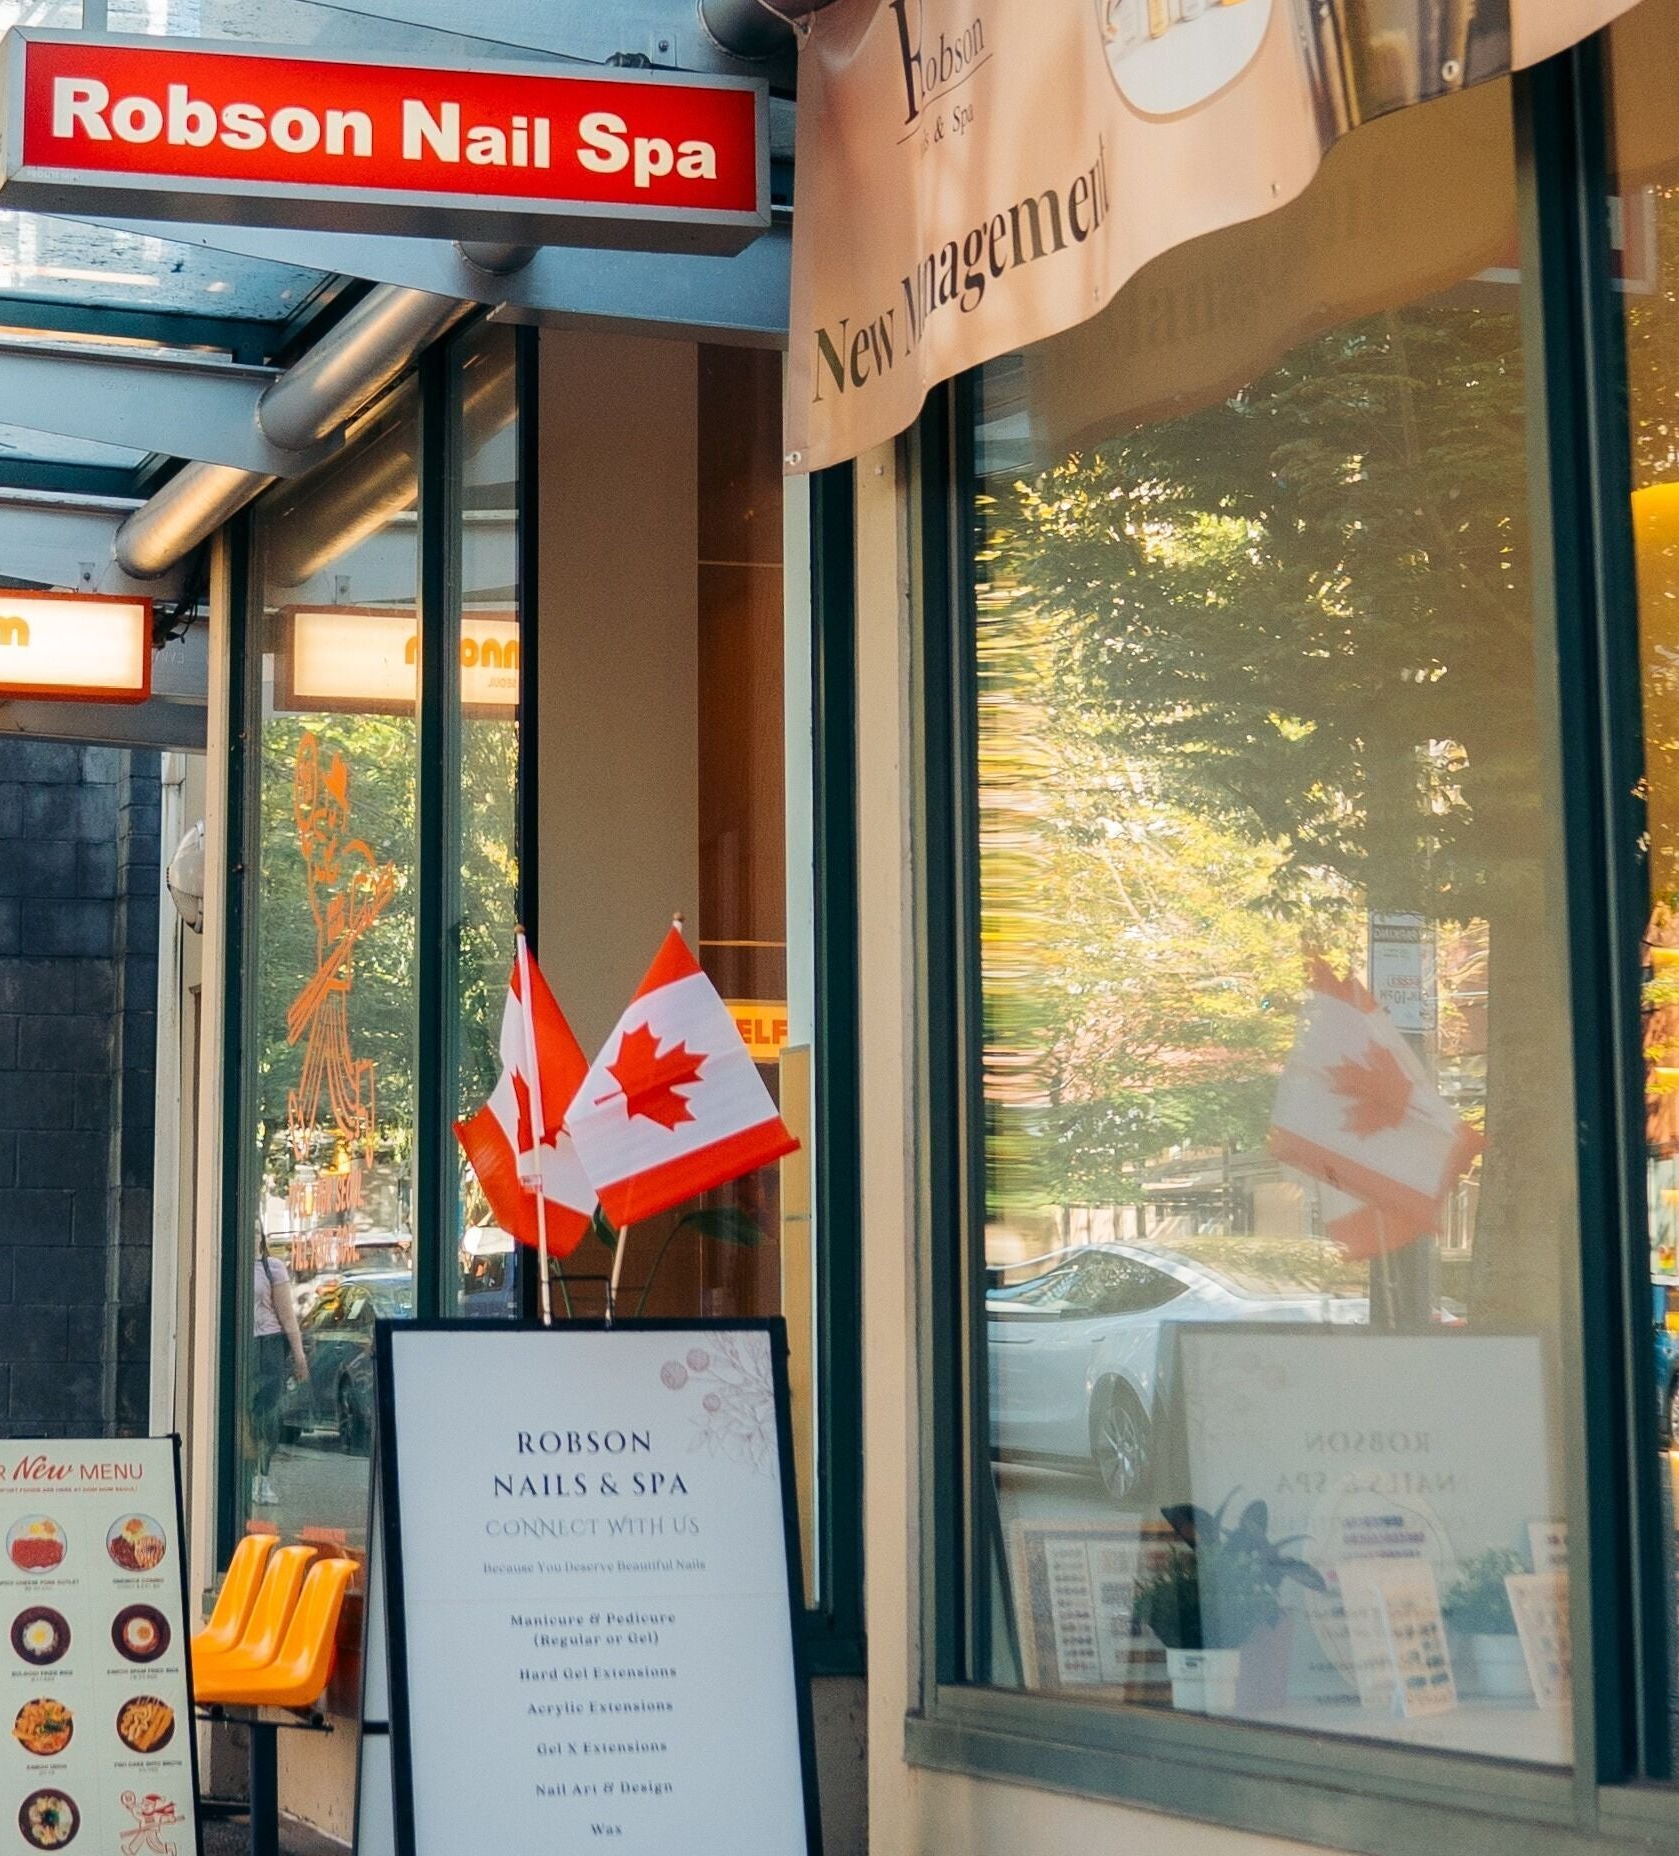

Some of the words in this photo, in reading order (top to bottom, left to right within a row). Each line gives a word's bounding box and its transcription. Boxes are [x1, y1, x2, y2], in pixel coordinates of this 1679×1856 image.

[52, 76, 373, 156] Robson
[402, 99, 550, 169] Nail
[576, 110, 718, 188] Spa
[812, 308, 895, 404] New
[902, 132, 1110, 358] Mnagement
[517, 1430, 652, 1454] ROBSON
[12, 1455, 74, 1481] New
[80, 1463, 143, 1481] MENU
[494, 1472, 588, 1497] NAILS
[600, 1472, 619, 1496] &
[633, 1471, 689, 1495] SPA
[485, 1517, 600, 1538] CONNECT
[606, 1514, 664, 1536] WITH
[673, 1513, 700, 1535] US
[483, 1562, 534, 1574] Because
[537, 1562, 562, 1573] You
[564, 1561, 614, 1573] Deserve
[617, 1559, 673, 1571] Beautiful
[676, 1558, 707, 1570] Nails
[510, 1613, 584, 1627] Manicure
[590, 1612, 601, 1625] &
[606, 1611, 676, 1625] Pedicure
[534, 1632, 601, 1648] (Regular
[606, 1634, 623, 1645] or
[628, 1630, 659, 1645] Gel)
[519, 1667, 558, 1681] Hard
[563, 1667, 588, 1680] Gel
[593, 1664, 677, 1679] Extensions
[528, 1700, 584, 1717] Acrylic
[589, 1699, 673, 1713] Extensions
[537, 1742, 562, 1756] Gel
[567, 1741, 578, 1755] X
[583, 1738, 668, 1754] Extensions
[536, 1783, 566, 1797] Nail
[572, 1782, 598, 1796] Art
[603, 1781, 614, 1794] &
[620, 1780, 673, 1796] Design
[590, 1823, 624, 1836] Wax
